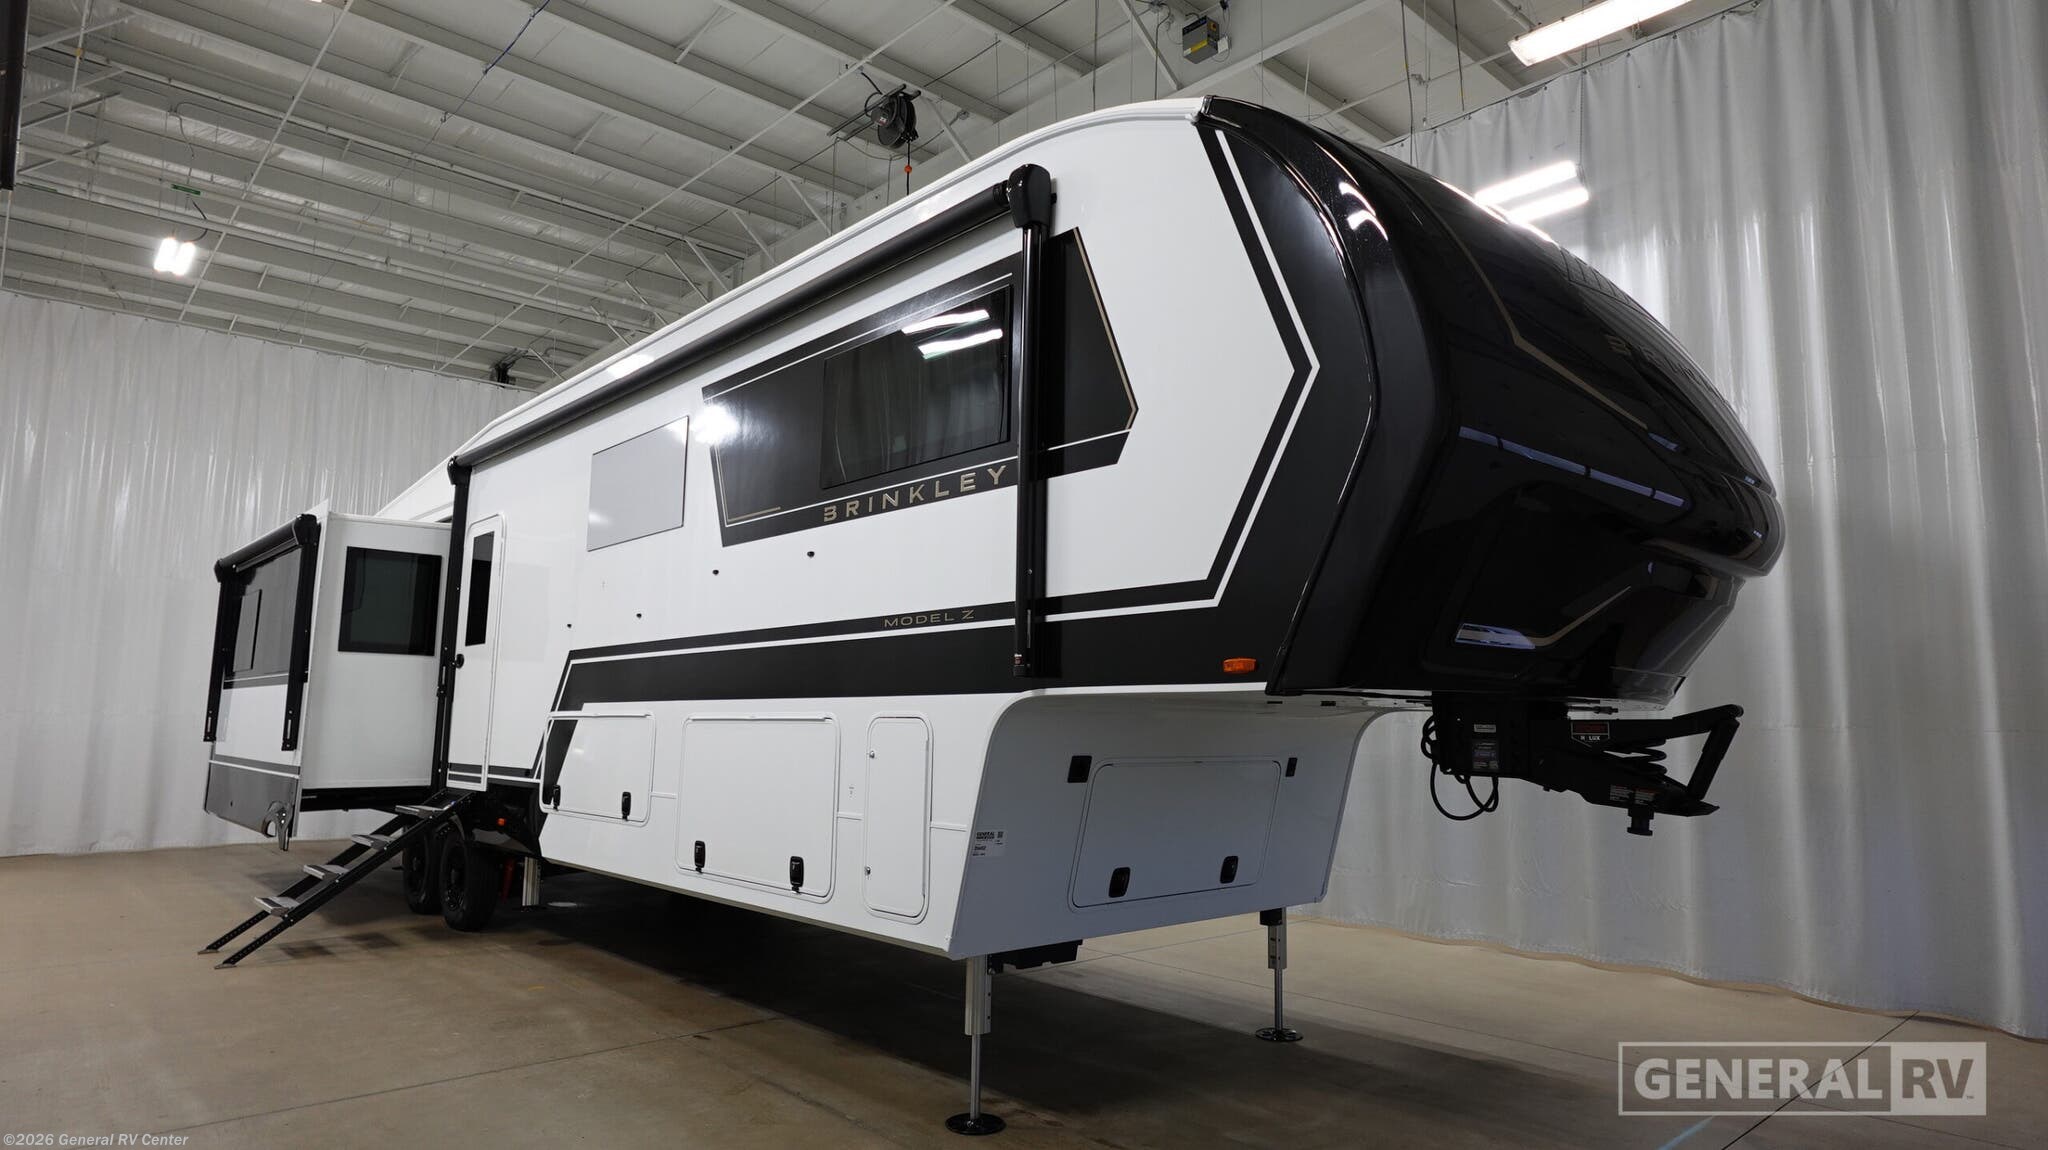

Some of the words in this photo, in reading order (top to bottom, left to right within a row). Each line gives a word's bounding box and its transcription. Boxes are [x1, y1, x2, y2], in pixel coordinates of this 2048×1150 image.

[823, 465, 1007, 522] BRINKLEY
[884, 612, 955, 628] MODEL
[962, 609, 975, 620] Z
